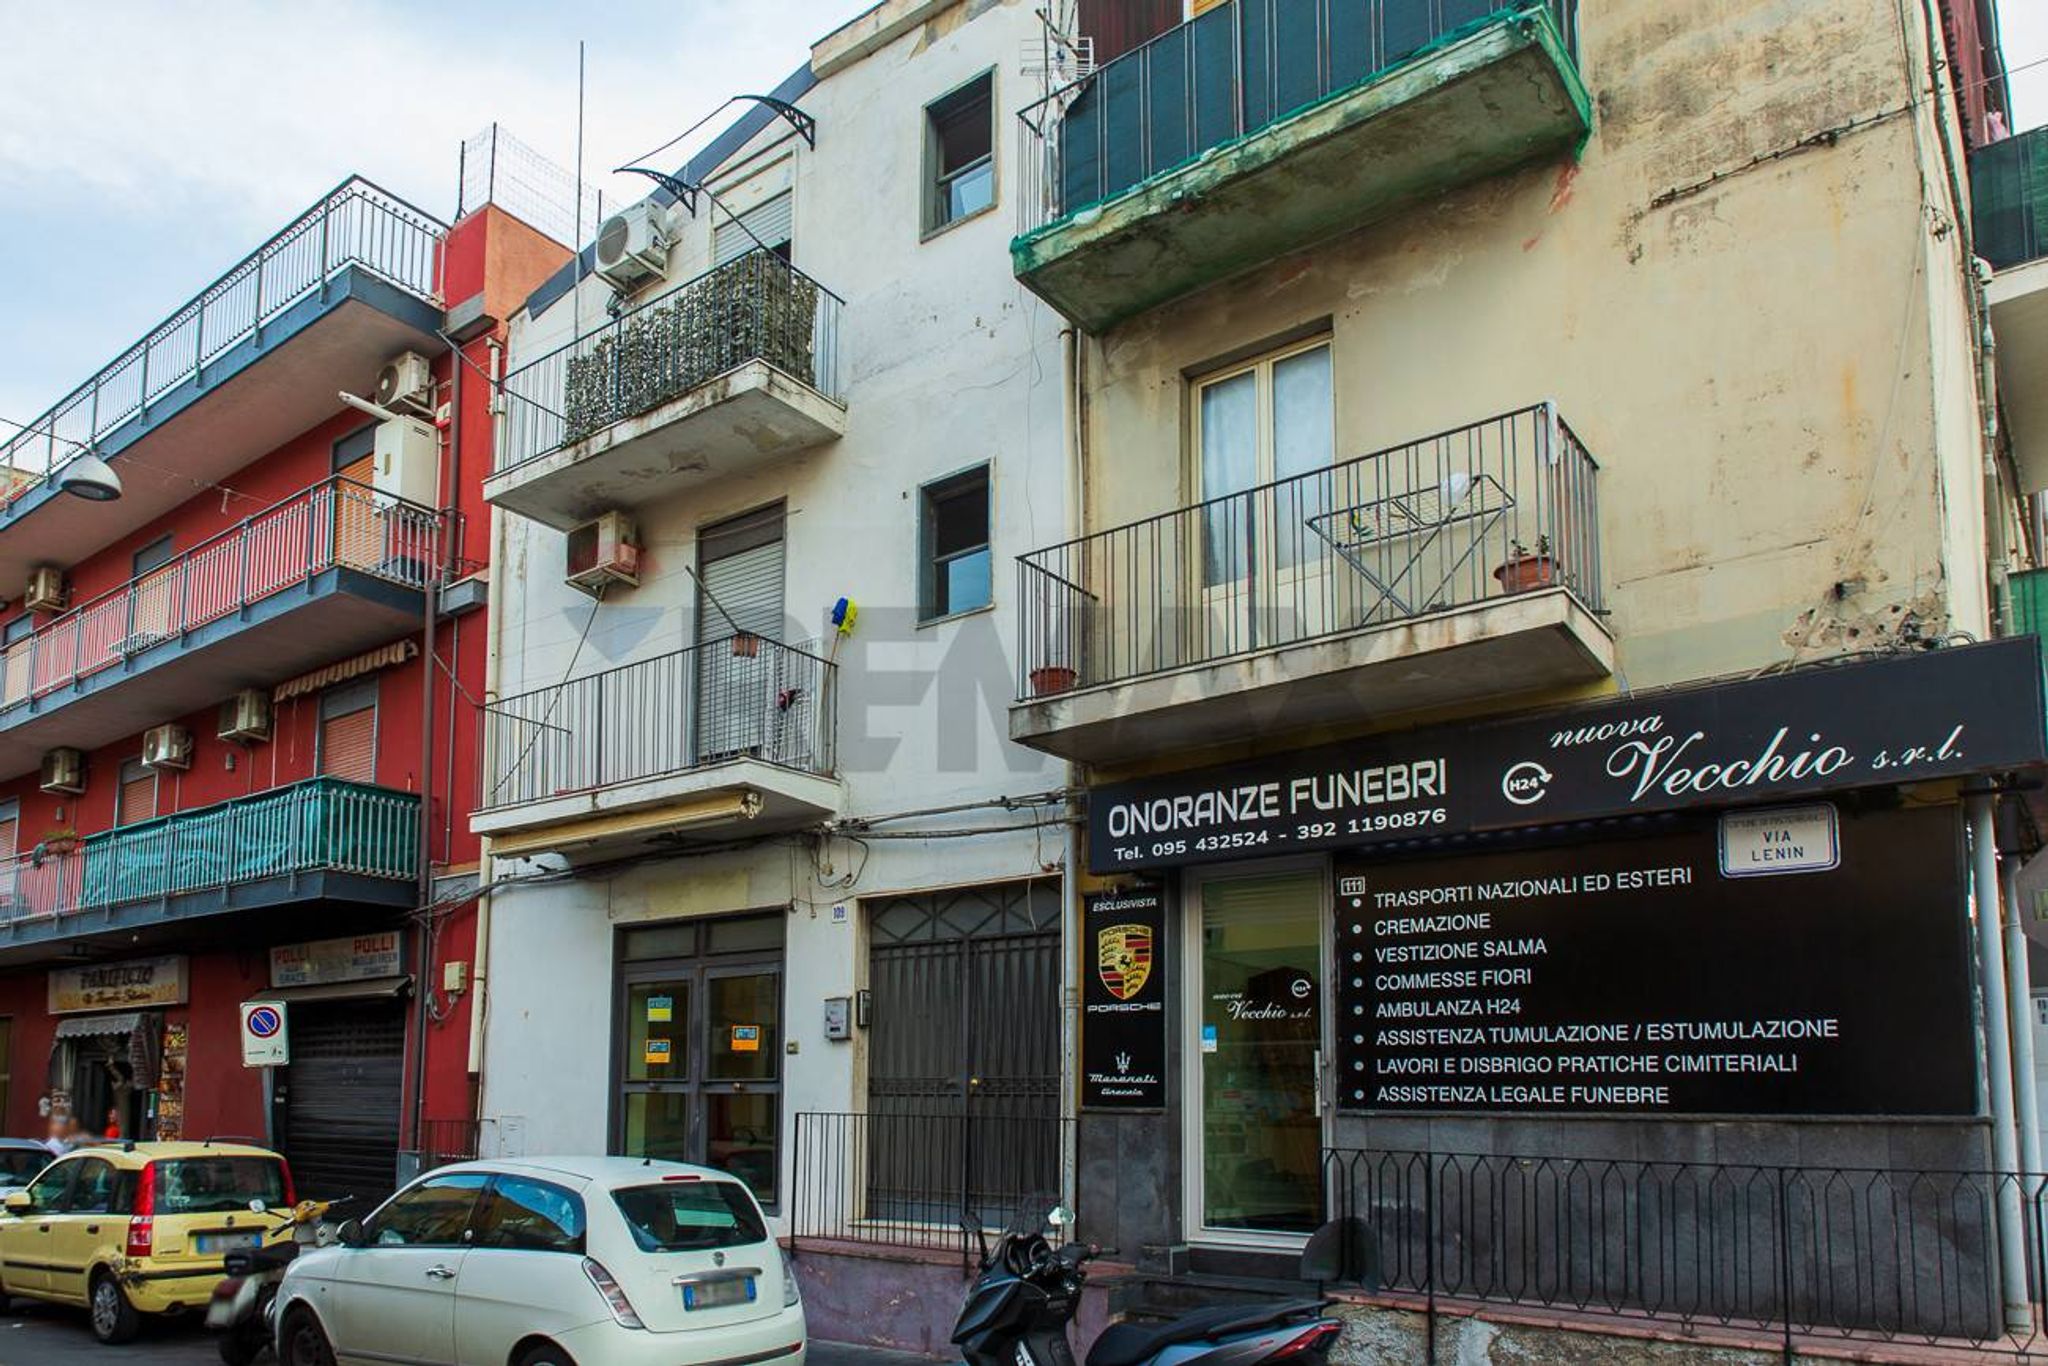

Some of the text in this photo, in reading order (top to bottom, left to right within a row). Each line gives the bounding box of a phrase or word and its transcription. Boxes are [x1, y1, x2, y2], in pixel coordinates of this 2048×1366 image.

[1550, 714, 1664, 749] nuova
[1607, 724, 1965, 802] Vecchio s.r.l.
[1509, 777, 1538, 793] H24
[1108, 758, 1447, 838] ONORANZE FUNEBRI
[1114, 846, 1144, 862] Tel.
[1152, 839, 1187, 858] 095
[1196, 829, 1269, 852] 432524
[1297, 821, 1337, 840] 392
[1348, 807, 1447, 834] 1190876
[1763, 830, 1791, 843] VIA
[1752, 846, 1804, 862] LENIN
[1344, 880, 1363, 893] 111
[1374, 866, 1692, 908] TRASPORTI NAZIONALI ED ESTERI
[1092, 898, 1157, 912] ESCLUSIVISTA
[1374, 913, 1492, 936] CREMAZIONE
[354, 934, 395, 954] POLLI
[1375, 938, 1548, 963] VESTIZIONE SALMA
[1375, 968, 1532, 991] COMMESSE FIORI
[1087, 1002, 1161, 1012] PORSCHE
[1226, 1000, 1288, 1020] Vecchio
[1376, 998, 1521, 1018] AMBULANZA H24
[1376, 1028, 1486, 1046] ASSISTENZA
[1488, 1024, 1629, 1044] TUMULAZIONE
[1647, 1018, 1840, 1042] ESTUMULAZIONE
[1376, 1053, 1798, 1074] LAVORI E DISBRIGO PRATICHE CIMITERIALI
[1376, 1086, 1670, 1104] ASSISTENZA LEGALE FUNEBRE
